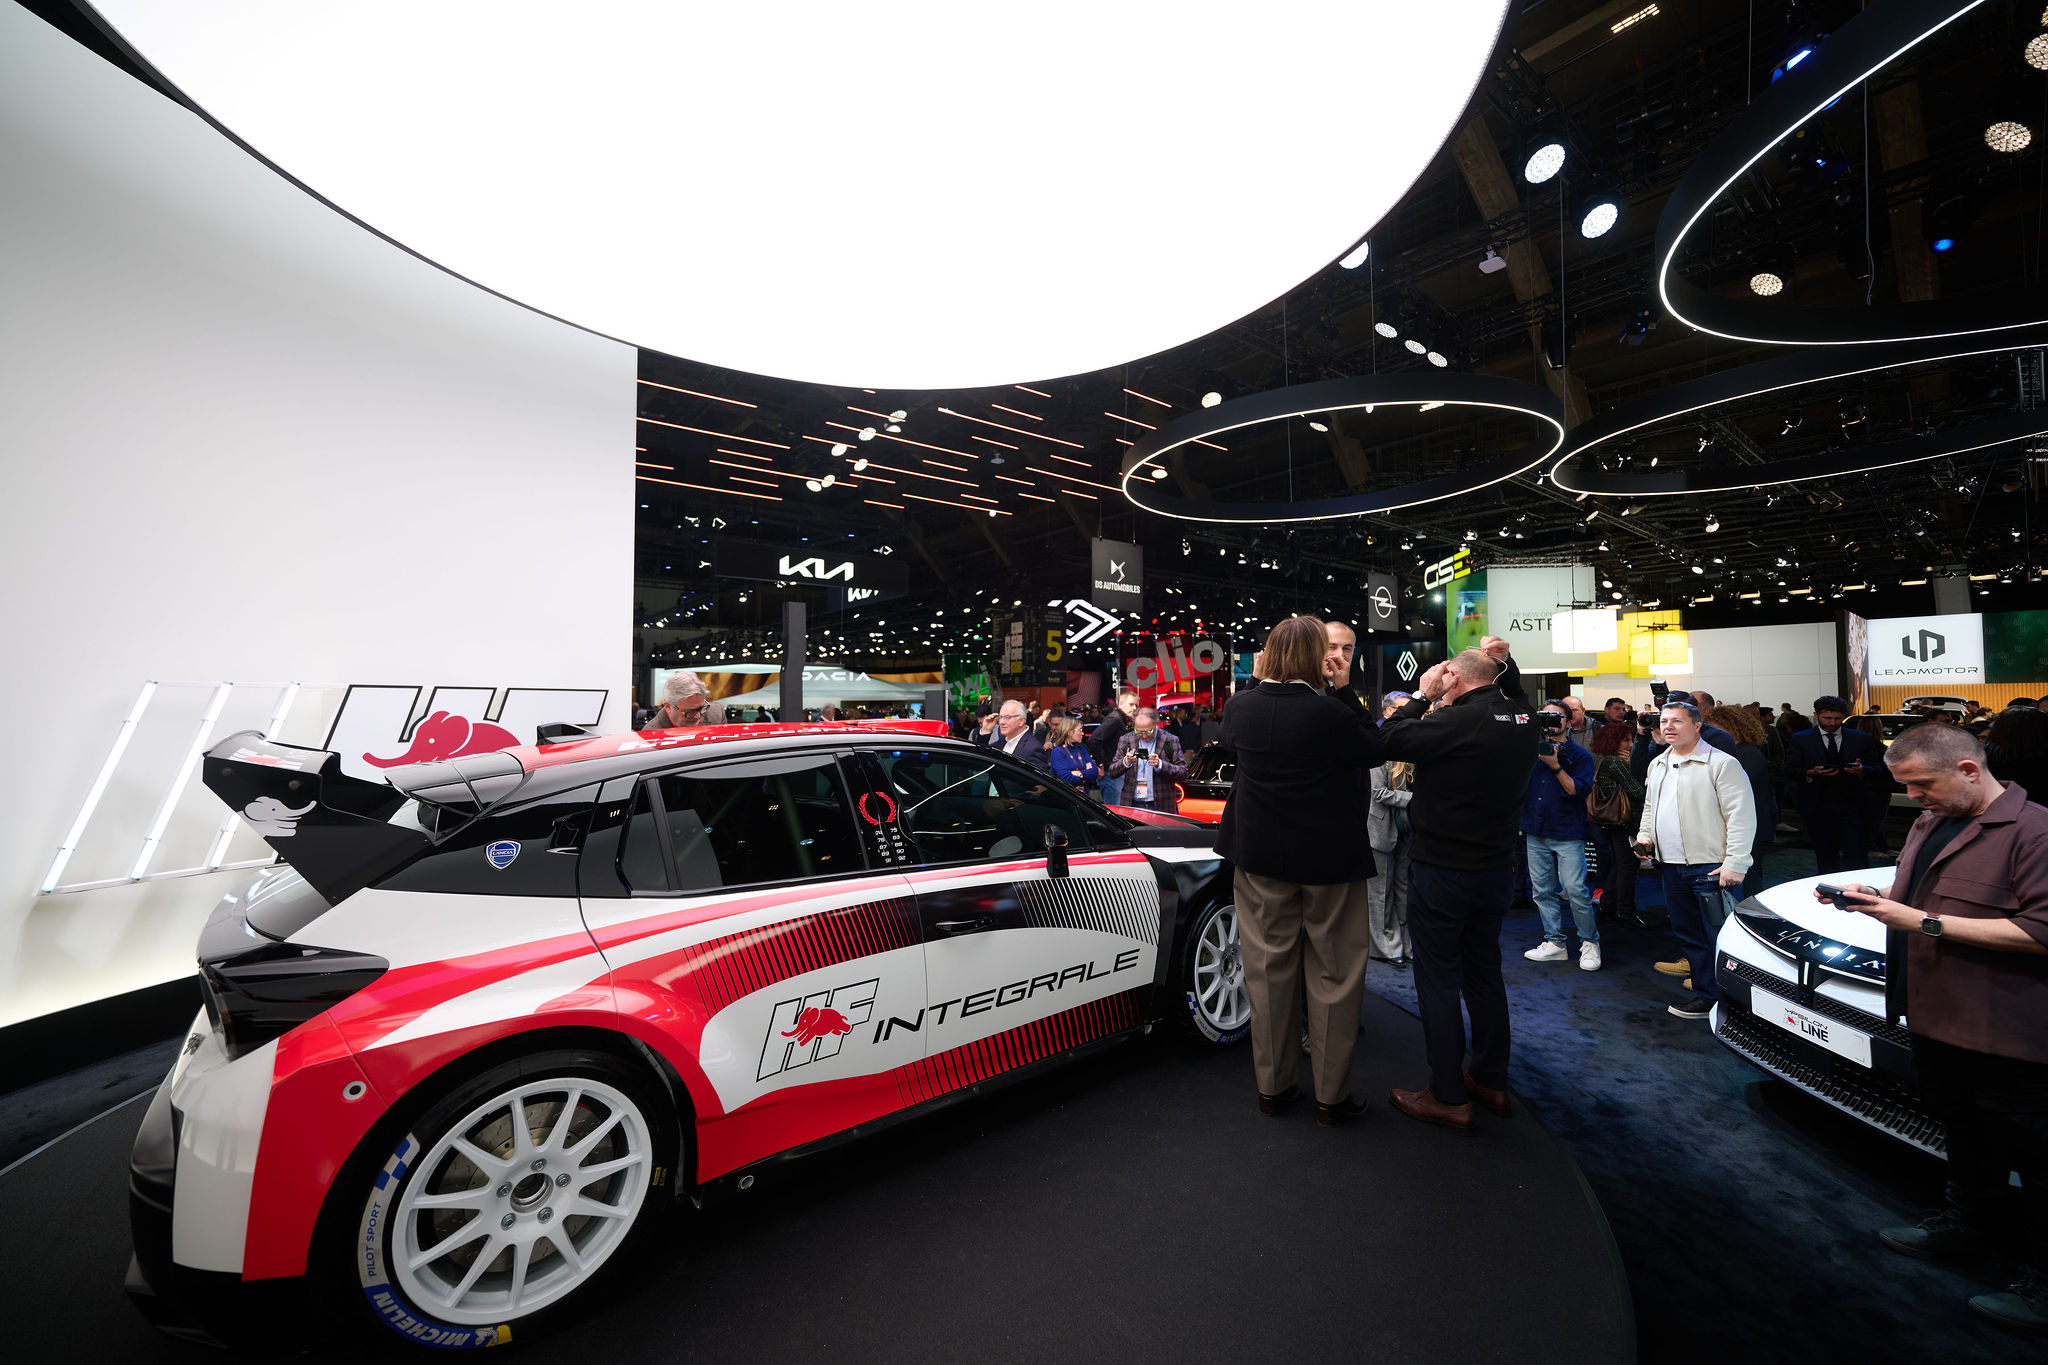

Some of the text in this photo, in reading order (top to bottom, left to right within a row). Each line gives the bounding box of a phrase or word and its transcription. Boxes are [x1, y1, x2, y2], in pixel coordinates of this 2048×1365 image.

[1095, 580, 1141, 594] DS AUTOMOBILES
[1424, 548, 1471, 591] GSE
[1045, 629, 1062, 662] 5
[1126, 636, 1224, 689] clio
[1874, 666, 1979, 676] LEAPMOTOR
[872, 948, 1141, 1045] INTEGRALE
[1784, 1007, 1829, 1031] YPSILON
[1800, 1021, 1830, 1043] LINE
[366, 1201, 381, 1277] PILOT SPORT
[373, 1291, 471, 1346] MICHELIN
